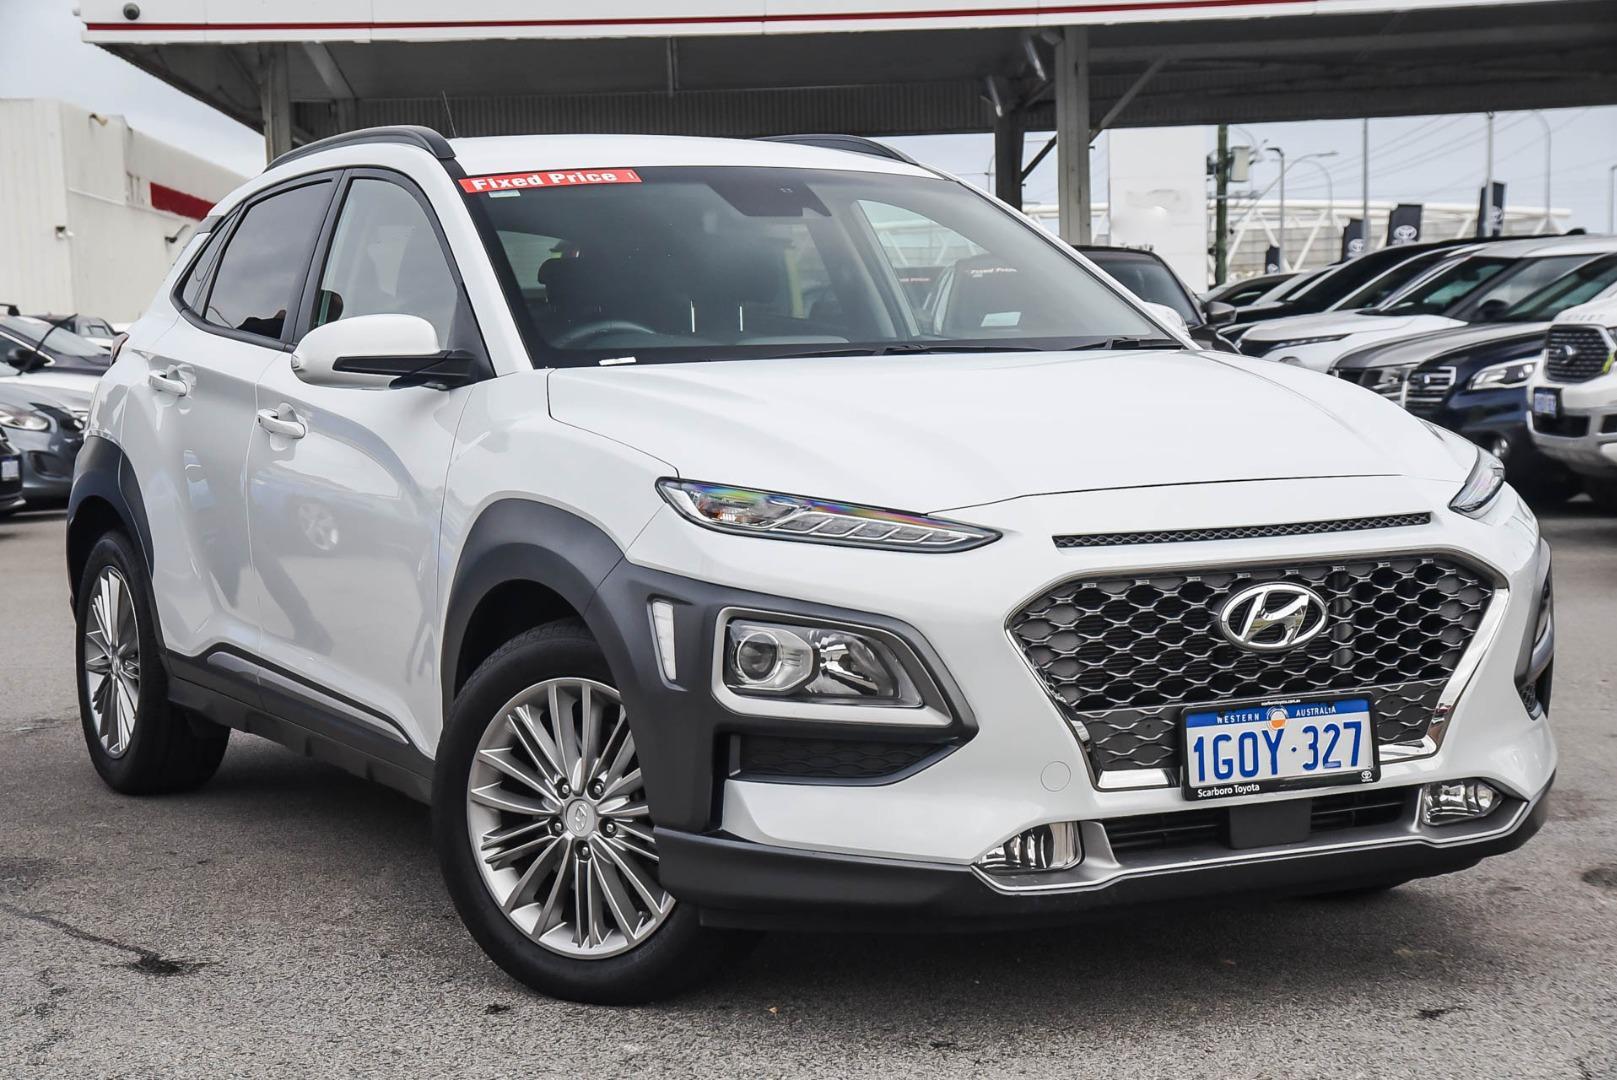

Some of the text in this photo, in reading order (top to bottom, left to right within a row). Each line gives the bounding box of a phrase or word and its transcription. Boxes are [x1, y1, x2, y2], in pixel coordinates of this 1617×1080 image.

[471, 174, 544, 191] Fixed
[549, 171, 618, 185] Price
[1216, 705, 1337, 724] WESTERN AUSTRALIA
[1197, 783, 1260, 798] Scarboro Toyota
